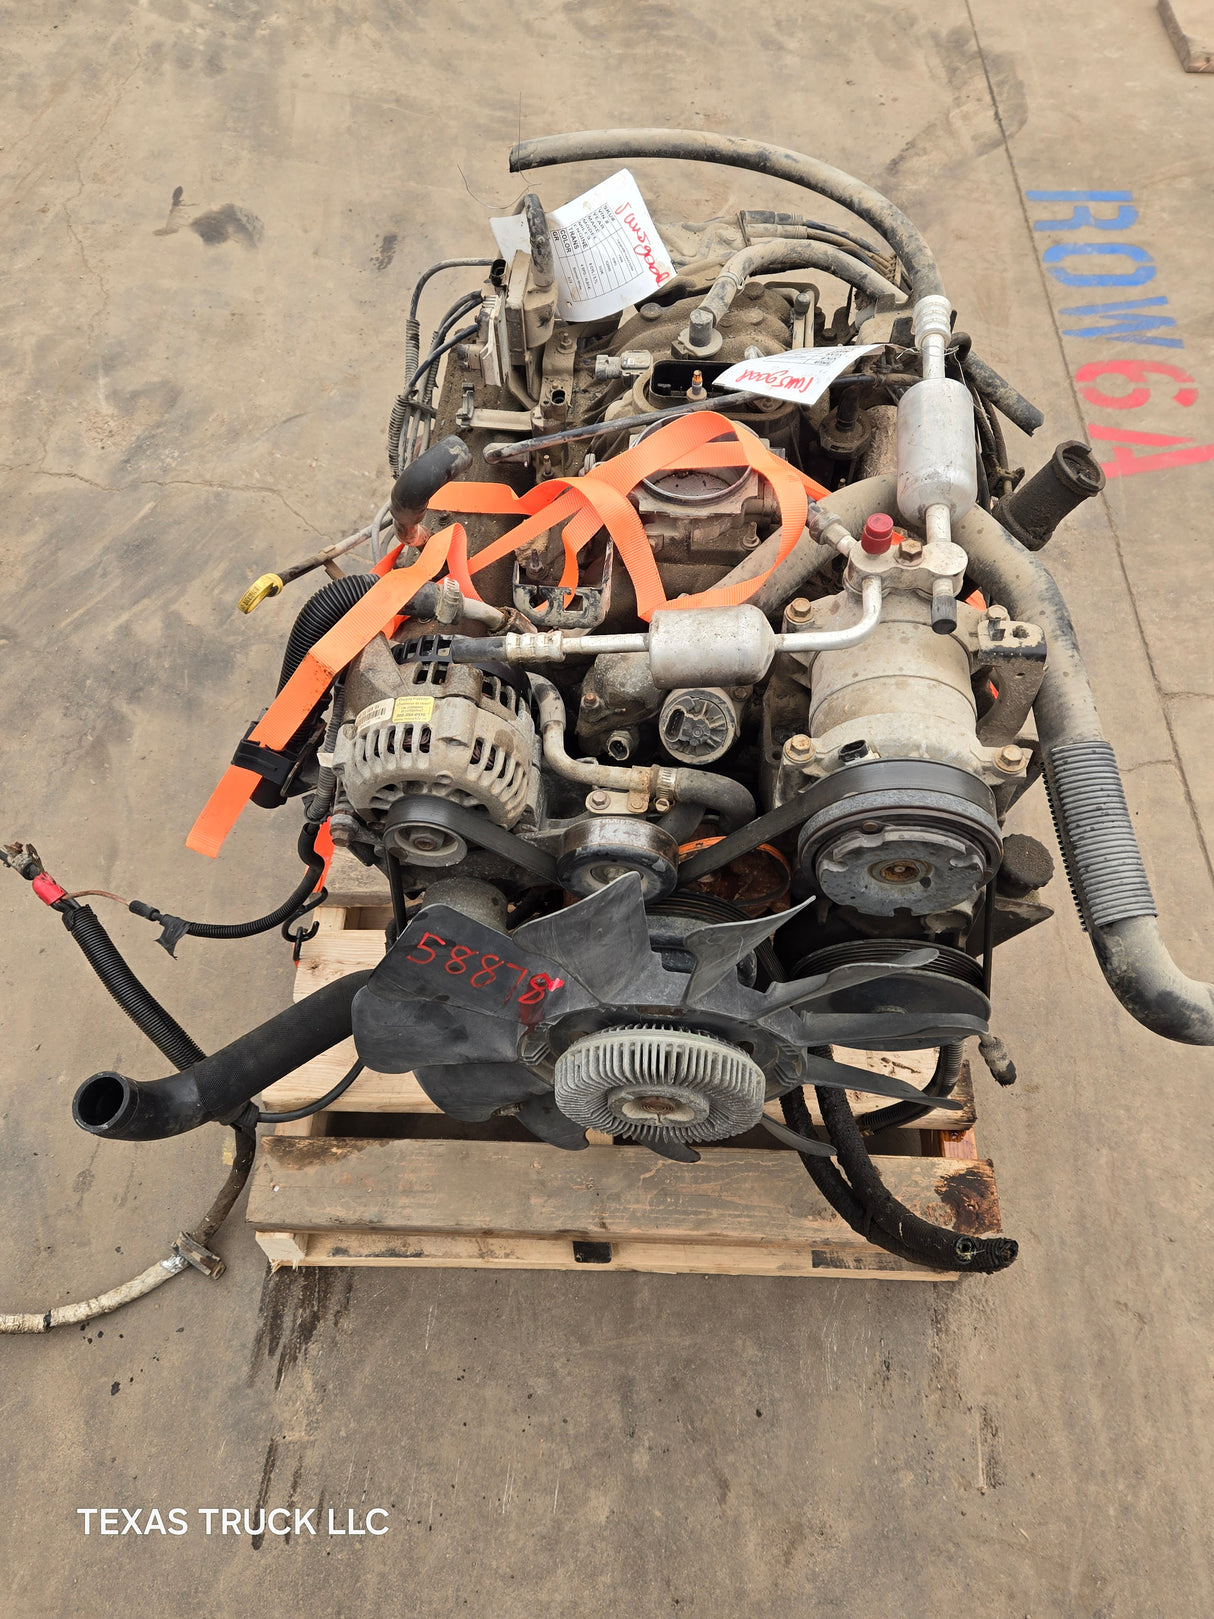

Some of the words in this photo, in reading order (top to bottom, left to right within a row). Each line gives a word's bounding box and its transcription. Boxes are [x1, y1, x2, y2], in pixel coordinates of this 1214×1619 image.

[560, 229, 572, 254] COLOR
[568, 227, 580, 250] TRANS
[1025, 189, 1185, 349] ROW
[1075, 360, 1214, 478] 6A
[406, 931, 553, 1005] 58878
